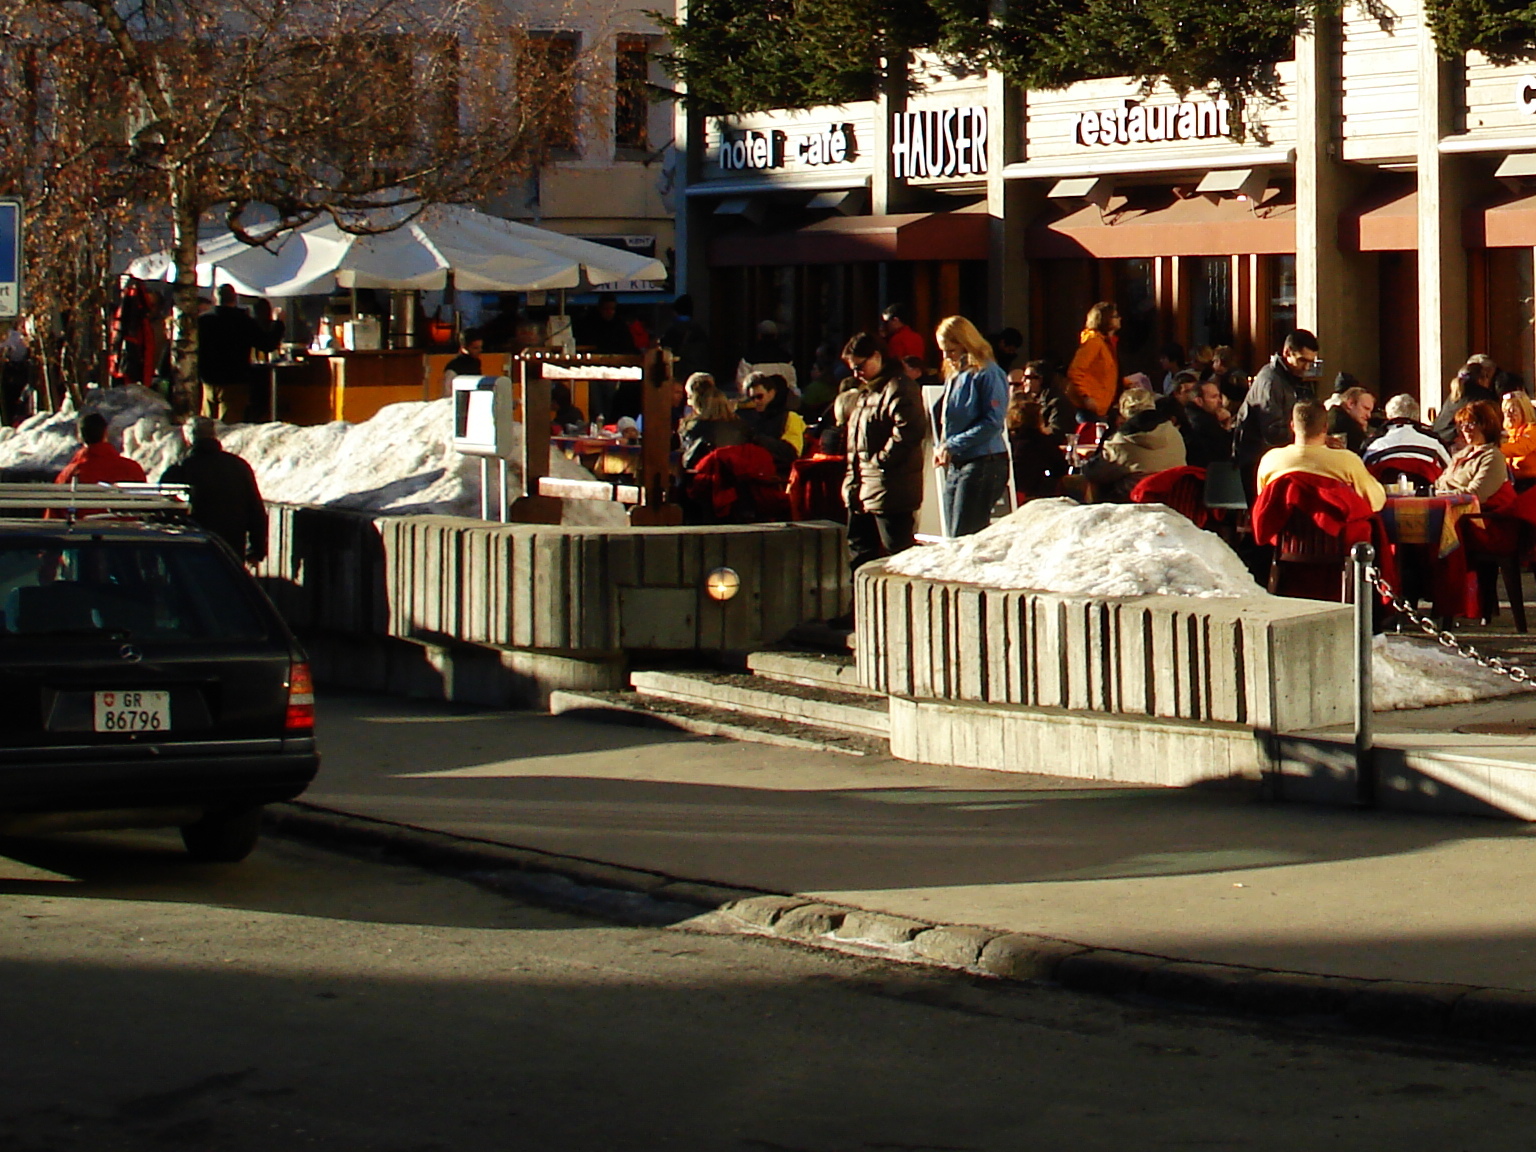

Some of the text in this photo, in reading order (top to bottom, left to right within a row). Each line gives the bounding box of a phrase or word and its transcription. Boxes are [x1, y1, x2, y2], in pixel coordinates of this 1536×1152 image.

[892, 105, 988, 179] HAUSER
[1069, 91, 1231, 146] restaurant
[719, 122, 848, 169] hotel café
[105, 711, 161, 730] 86796
[124, 693, 142, 708] GR
